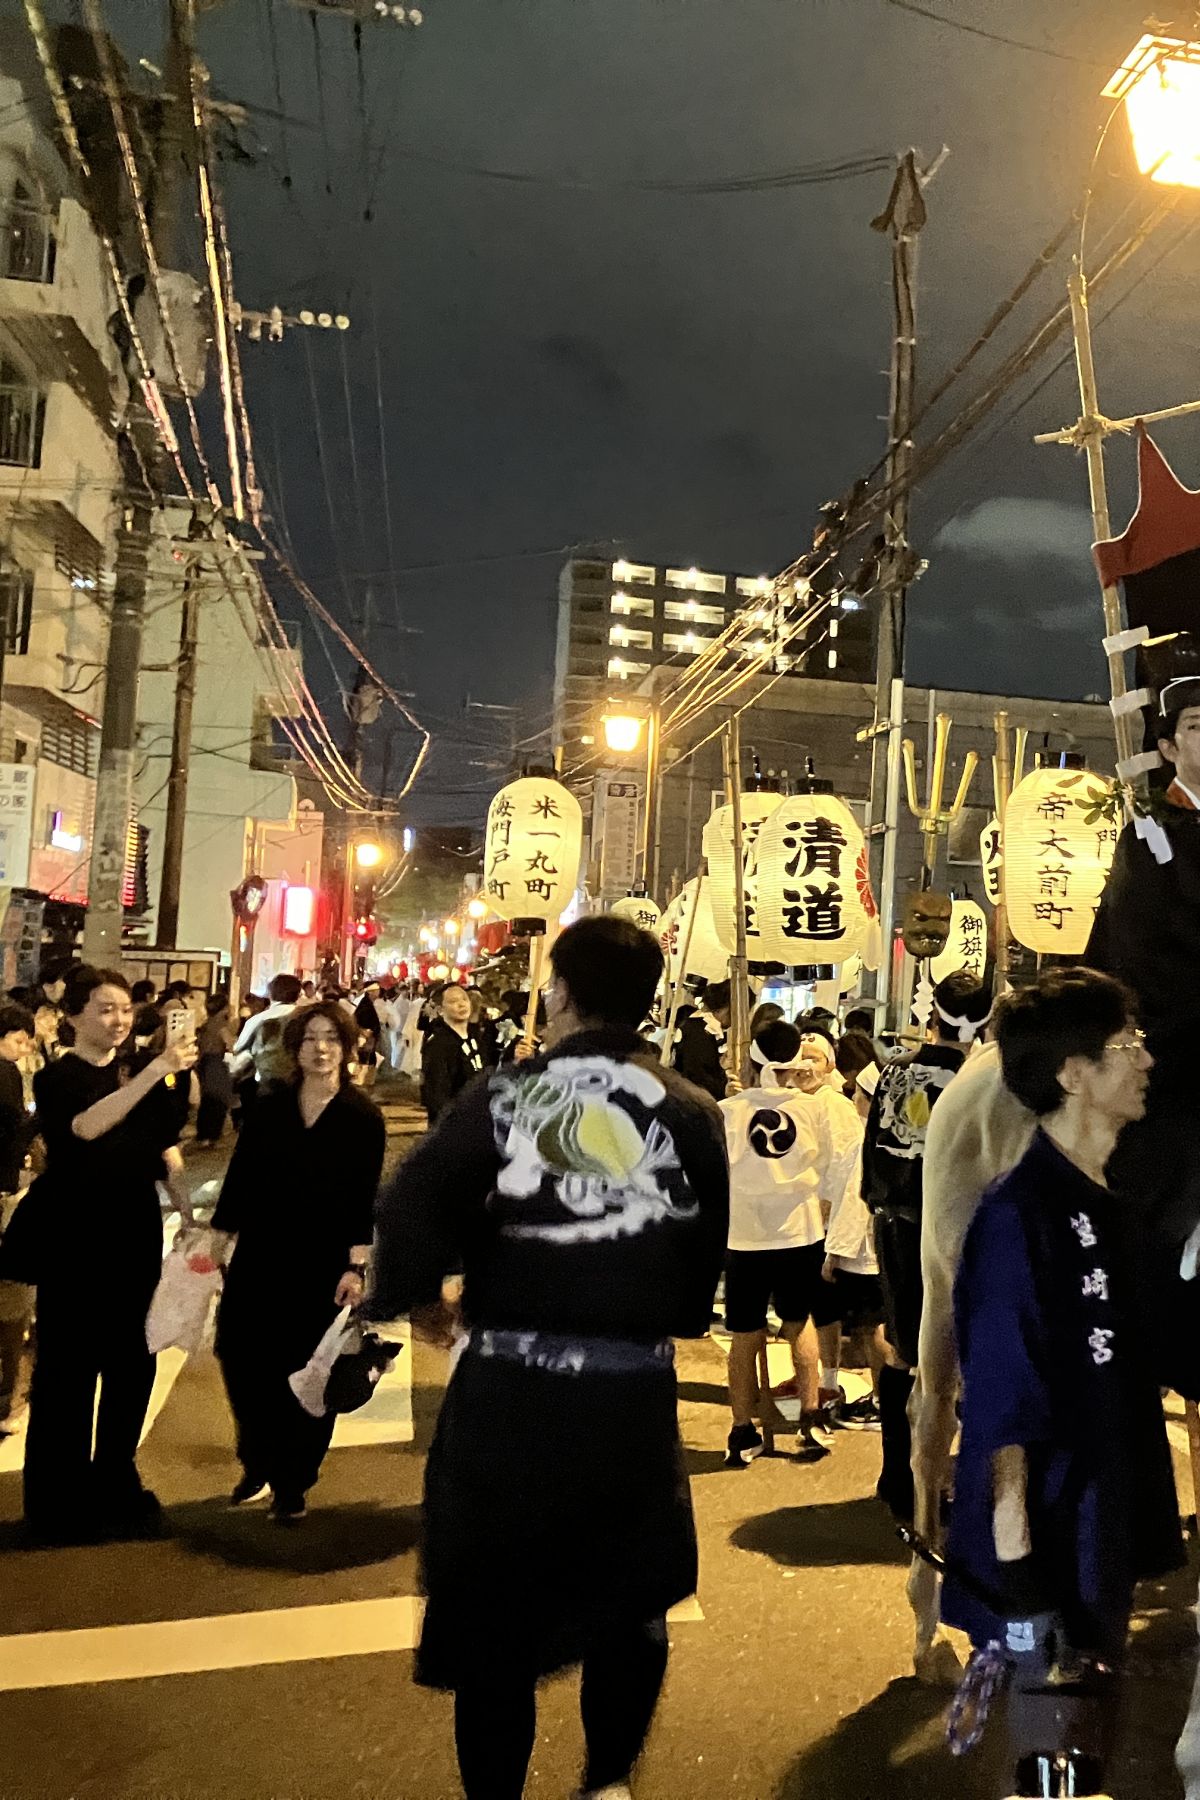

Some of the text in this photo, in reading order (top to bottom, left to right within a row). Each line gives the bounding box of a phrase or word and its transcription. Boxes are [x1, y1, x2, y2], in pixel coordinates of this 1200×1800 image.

[487, 793, 516, 902] 海門戸町
[524, 794, 562, 902] 米一丸町
[782, 816, 848, 941] 清道
[1033, 791, 1075, 930] 帝大前町
